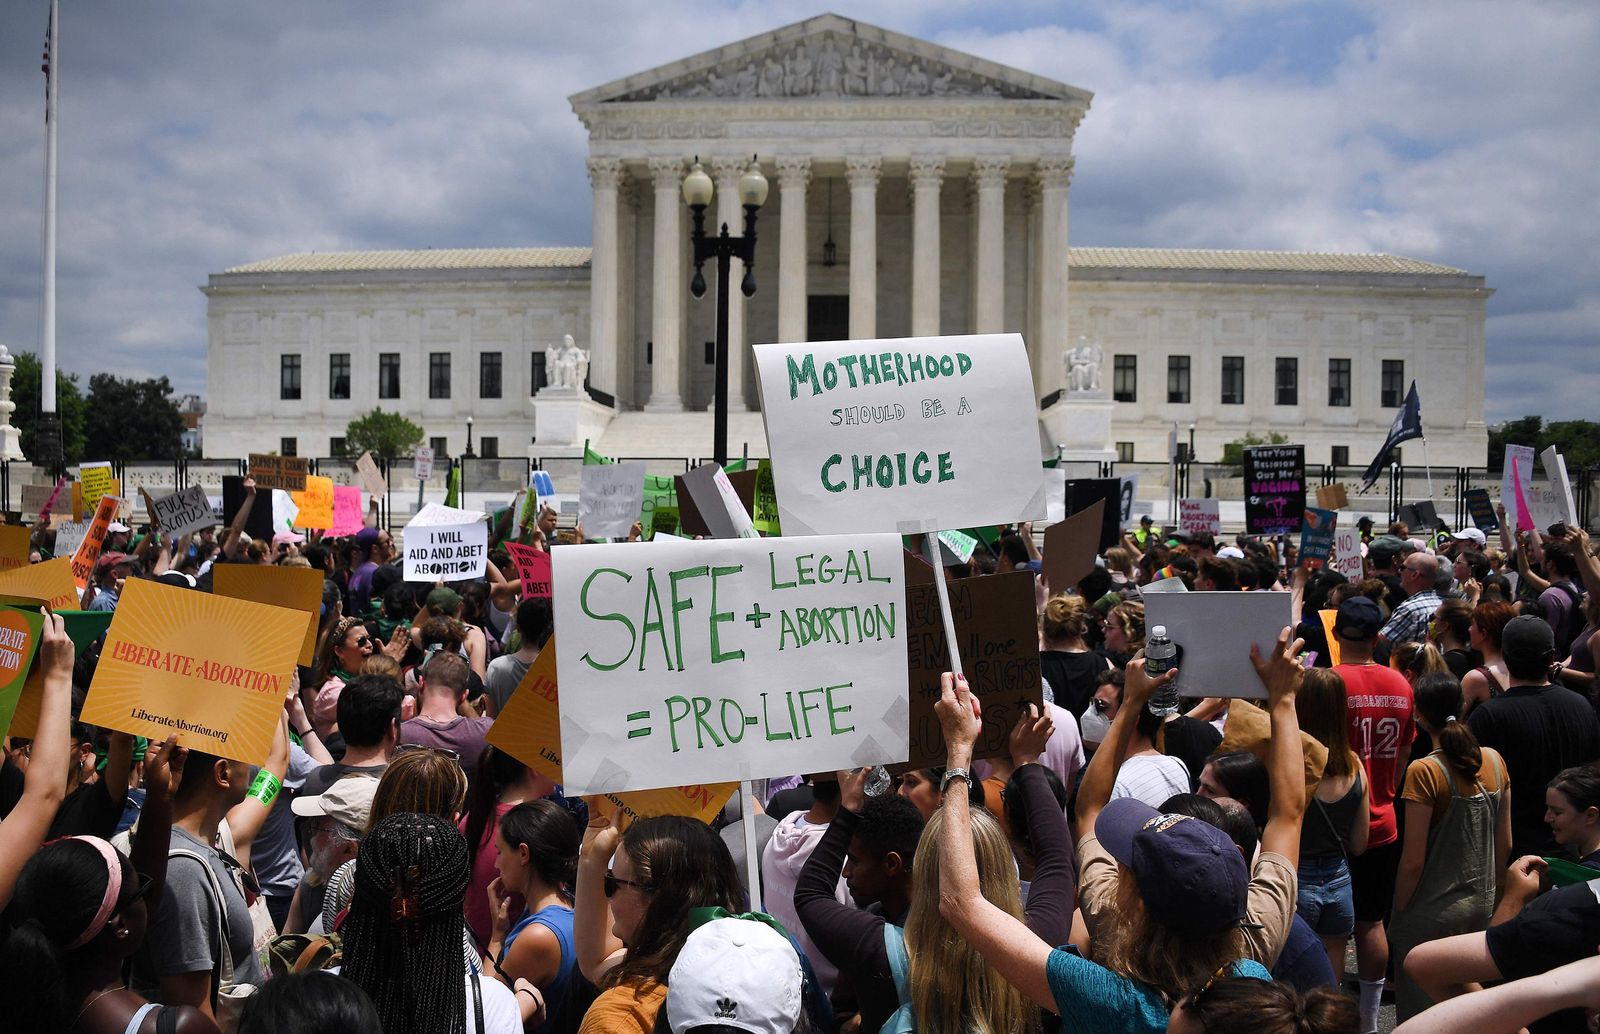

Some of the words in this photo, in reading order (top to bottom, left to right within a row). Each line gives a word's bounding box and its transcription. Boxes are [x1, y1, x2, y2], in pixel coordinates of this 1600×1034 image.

[786, 352, 973, 400] MOTHERHOOD
[830, 403, 906, 427] SHOULD
[921, 398, 946, 419] BE
[957, 396, 973, 416] A
[820, 451, 956, 493] CHOICE
[1251, 480, 1300, 493] VAGINA
[155, 493, 192, 518] FUCK
[430, 532, 434, 544] I
[437, 531, 463, 544] WILL
[1338, 534, 1352, 552] NO
[409, 548, 428, 560] AID
[430, 547, 453, 560] AND
[456, 544, 484, 558] ABET
[517, 557, 534, 566] AID
[414, 560, 477, 575] ABORTION
[523, 569, 531, 579] &
[769, 550, 891, 590] LEGAL
[527, 582, 549, 594] ABET
[580, 565, 746, 672] SAFE
[746, 603, 771, 628] +
[778, 602, 896, 650] ABORTION
[111, 640, 196, 677] LIBERATE
[196, 659, 283, 695] ABORTION
[1347, 695, 1409, 709] ORGANIZER
[131, 708, 229, 744] LiberateAbortion.org
[627, 711, 652, 739] =
[665, 682, 855, 753] PRO-LIFE
[714, 1011, 737, 1019] adidas
